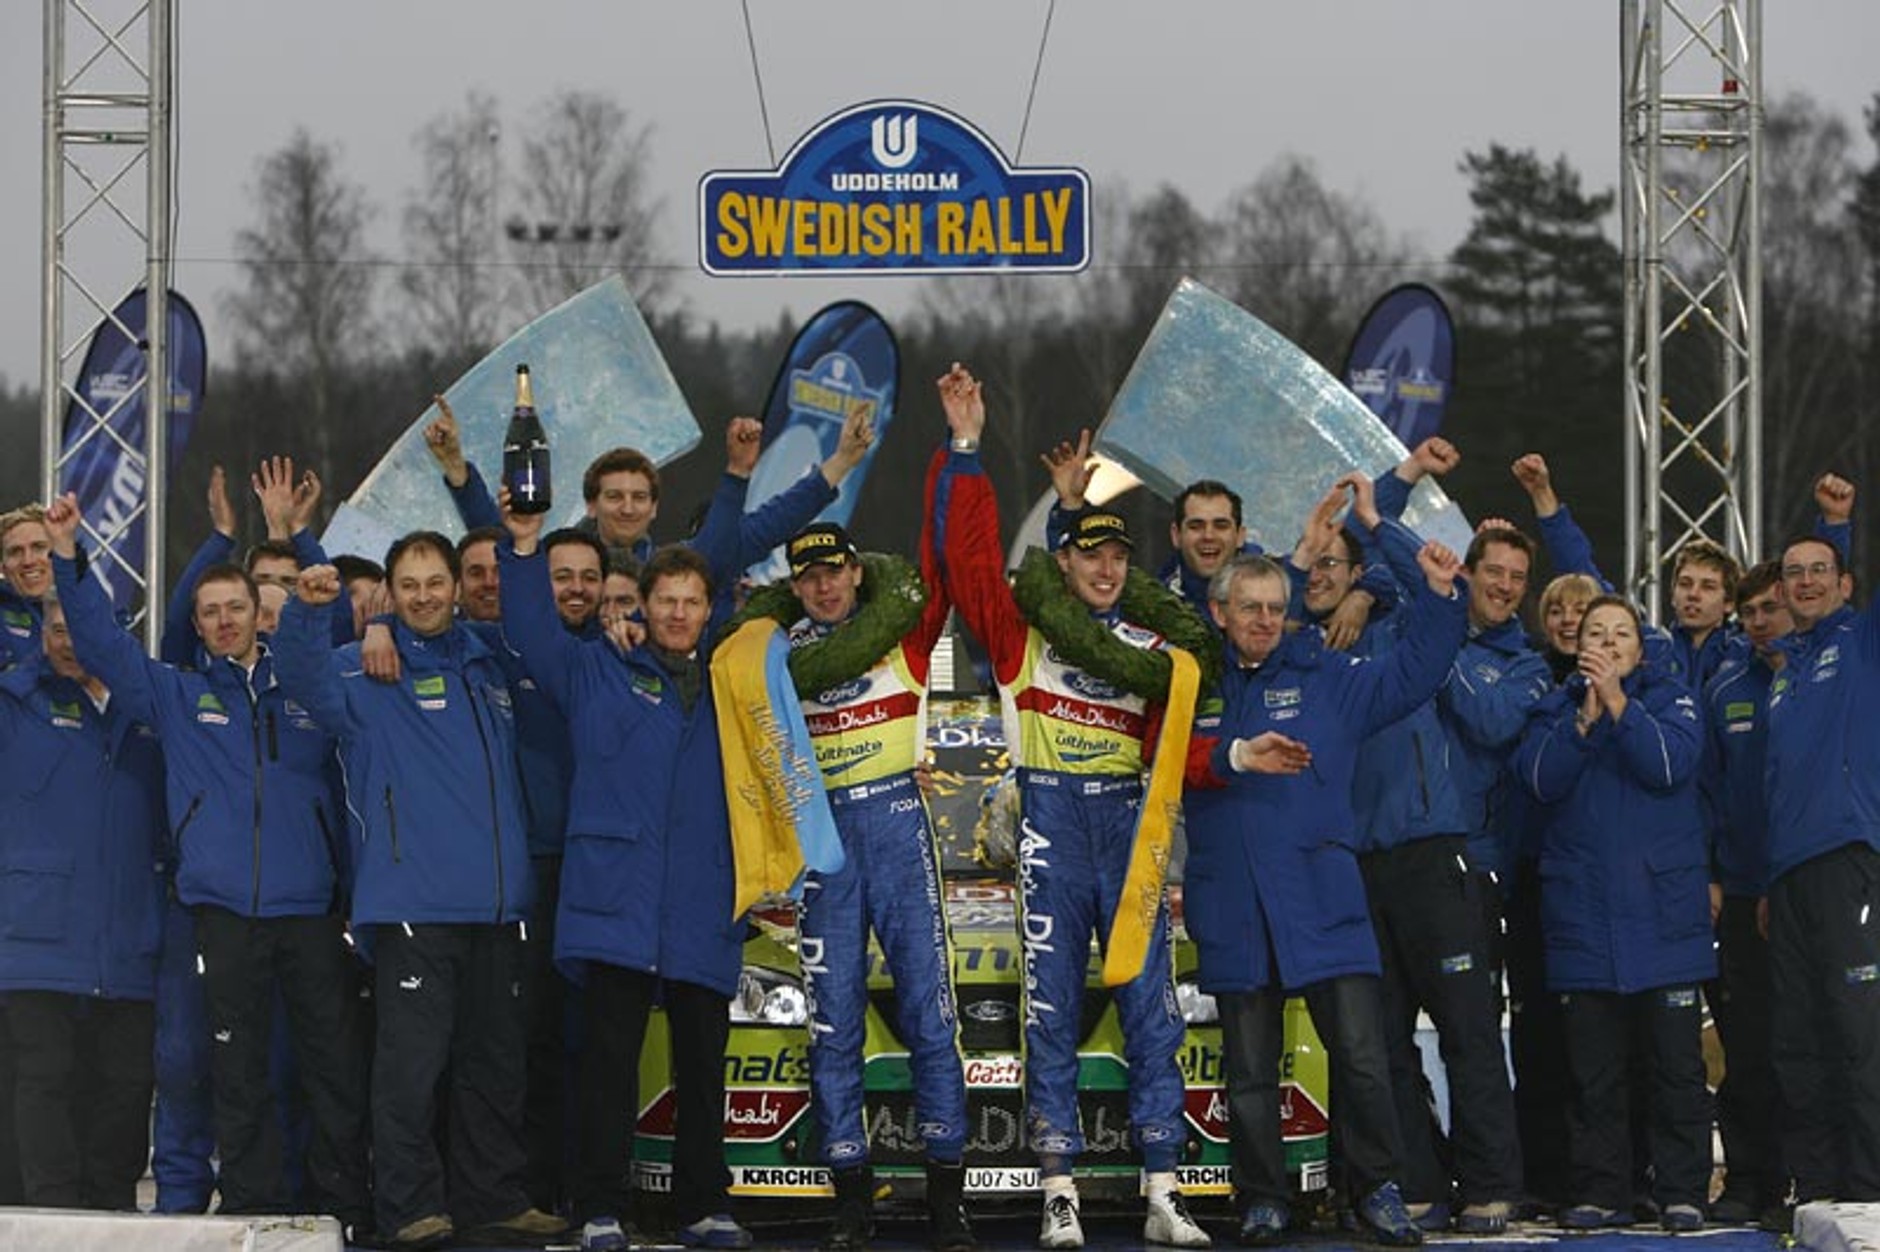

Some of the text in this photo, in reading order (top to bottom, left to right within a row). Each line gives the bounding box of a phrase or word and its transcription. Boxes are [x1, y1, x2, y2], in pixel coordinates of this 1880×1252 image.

[831, 172, 959, 192] UDDEHOLM
[717, 187, 1072, 257] SWEDISH RALLY
[724, 1092, 781, 1124] habi
[742, 1169, 832, 1185] KÄRCHE
